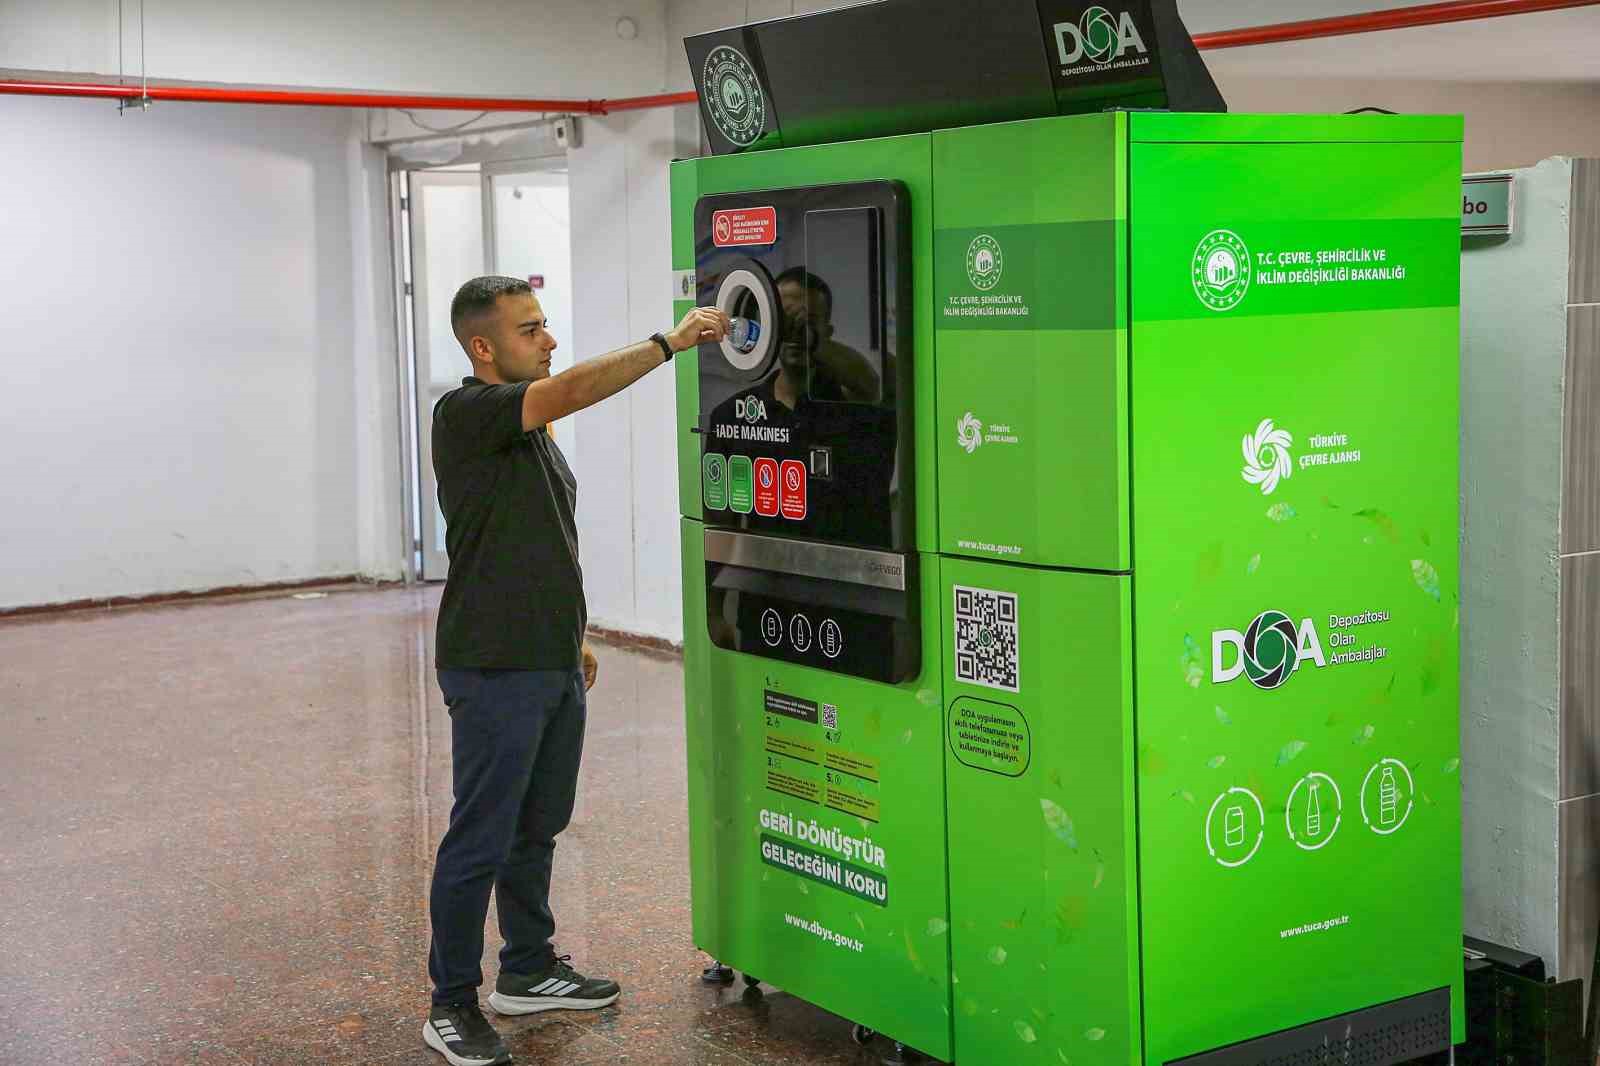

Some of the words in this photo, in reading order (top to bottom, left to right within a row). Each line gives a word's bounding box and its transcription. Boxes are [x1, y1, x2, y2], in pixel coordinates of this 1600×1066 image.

[1053, 6, 1148, 65] DOA
[1256, 252, 1276, 265] T.C.
[1278, 250, 1313, 268] ÇEVRE,
[1315, 247, 1371, 266] ŞEHİRCİLİK
[1373, 249, 1386, 261] VE
[1256, 270, 1287, 285] İKLİM
[1288, 266, 1349, 286] DEĞİŞİKLİĞİ
[1351, 264, 1406, 281] BAKANLIĞI
[1013, 296, 1023, 304] VE
[735, 395, 768, 423] DOA
[1308, 432, 1348, 449] TÜRKİYE
[1299, 452, 1328, 470] ÇEVRE
[1329, 448, 1361, 465] AJANSI
[1329, 609, 1391, 629] Depozitosu
[1211, 610, 1327, 689] DOA
[1329, 633, 1356, 647] Olan
[1329, 645, 1387, 665] Ambalajlar
[961, 708, 976, 719] DOA
[760, 808, 793, 836] GERİ
[797, 820, 885, 868] DÖNÜŞTÜR
[762, 841, 841, 885] GELECEĞİNİ
[845, 869, 886, 901] KORU
[784, 911, 864, 952] www.dbys.gov.tr
[1279, 915, 1349, 938] www.tuca.gov.tr
